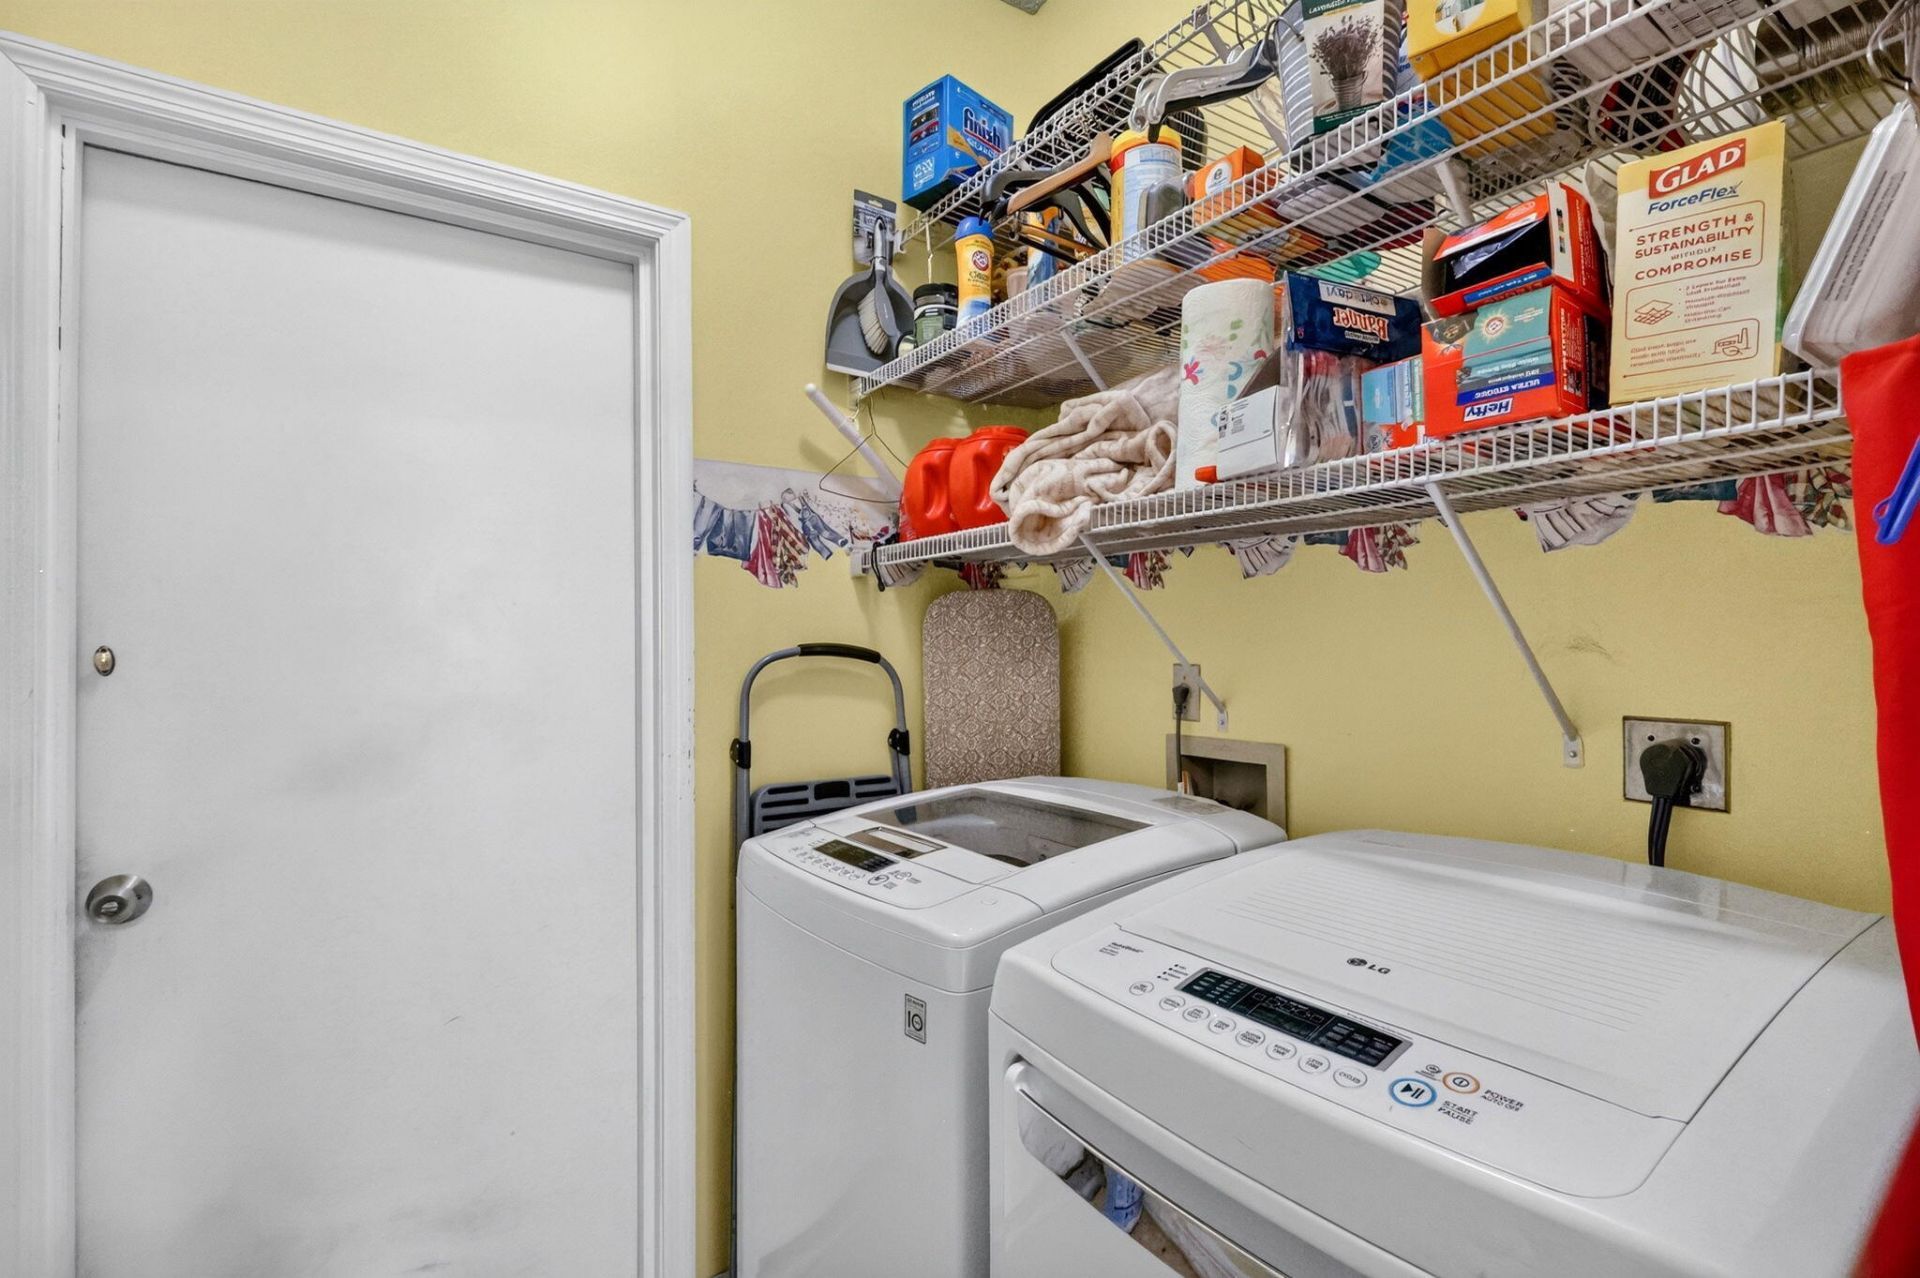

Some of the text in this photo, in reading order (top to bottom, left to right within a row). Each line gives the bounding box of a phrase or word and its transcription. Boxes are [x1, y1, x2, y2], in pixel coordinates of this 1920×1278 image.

[962, 106, 1001, 150] finish
[1655, 145, 1741, 193] GLAD
[1648, 182, 1743, 215] ForceFlex
[1635, 225, 1754, 259] SUSTAINABILITY
[1636, 212, 1753, 246] STRENGTH &
[1634, 249, 1752, 281] COMPROMISE
[1671, 246, 1716, 260] WITHOUT
[1466, 400, 1510, 419] Hefty
[1442, 1100, 1479, 1117] START
[1484, 1089, 1524, 1108] POWER
[1437, 1107, 1474, 1125] PAUSE
